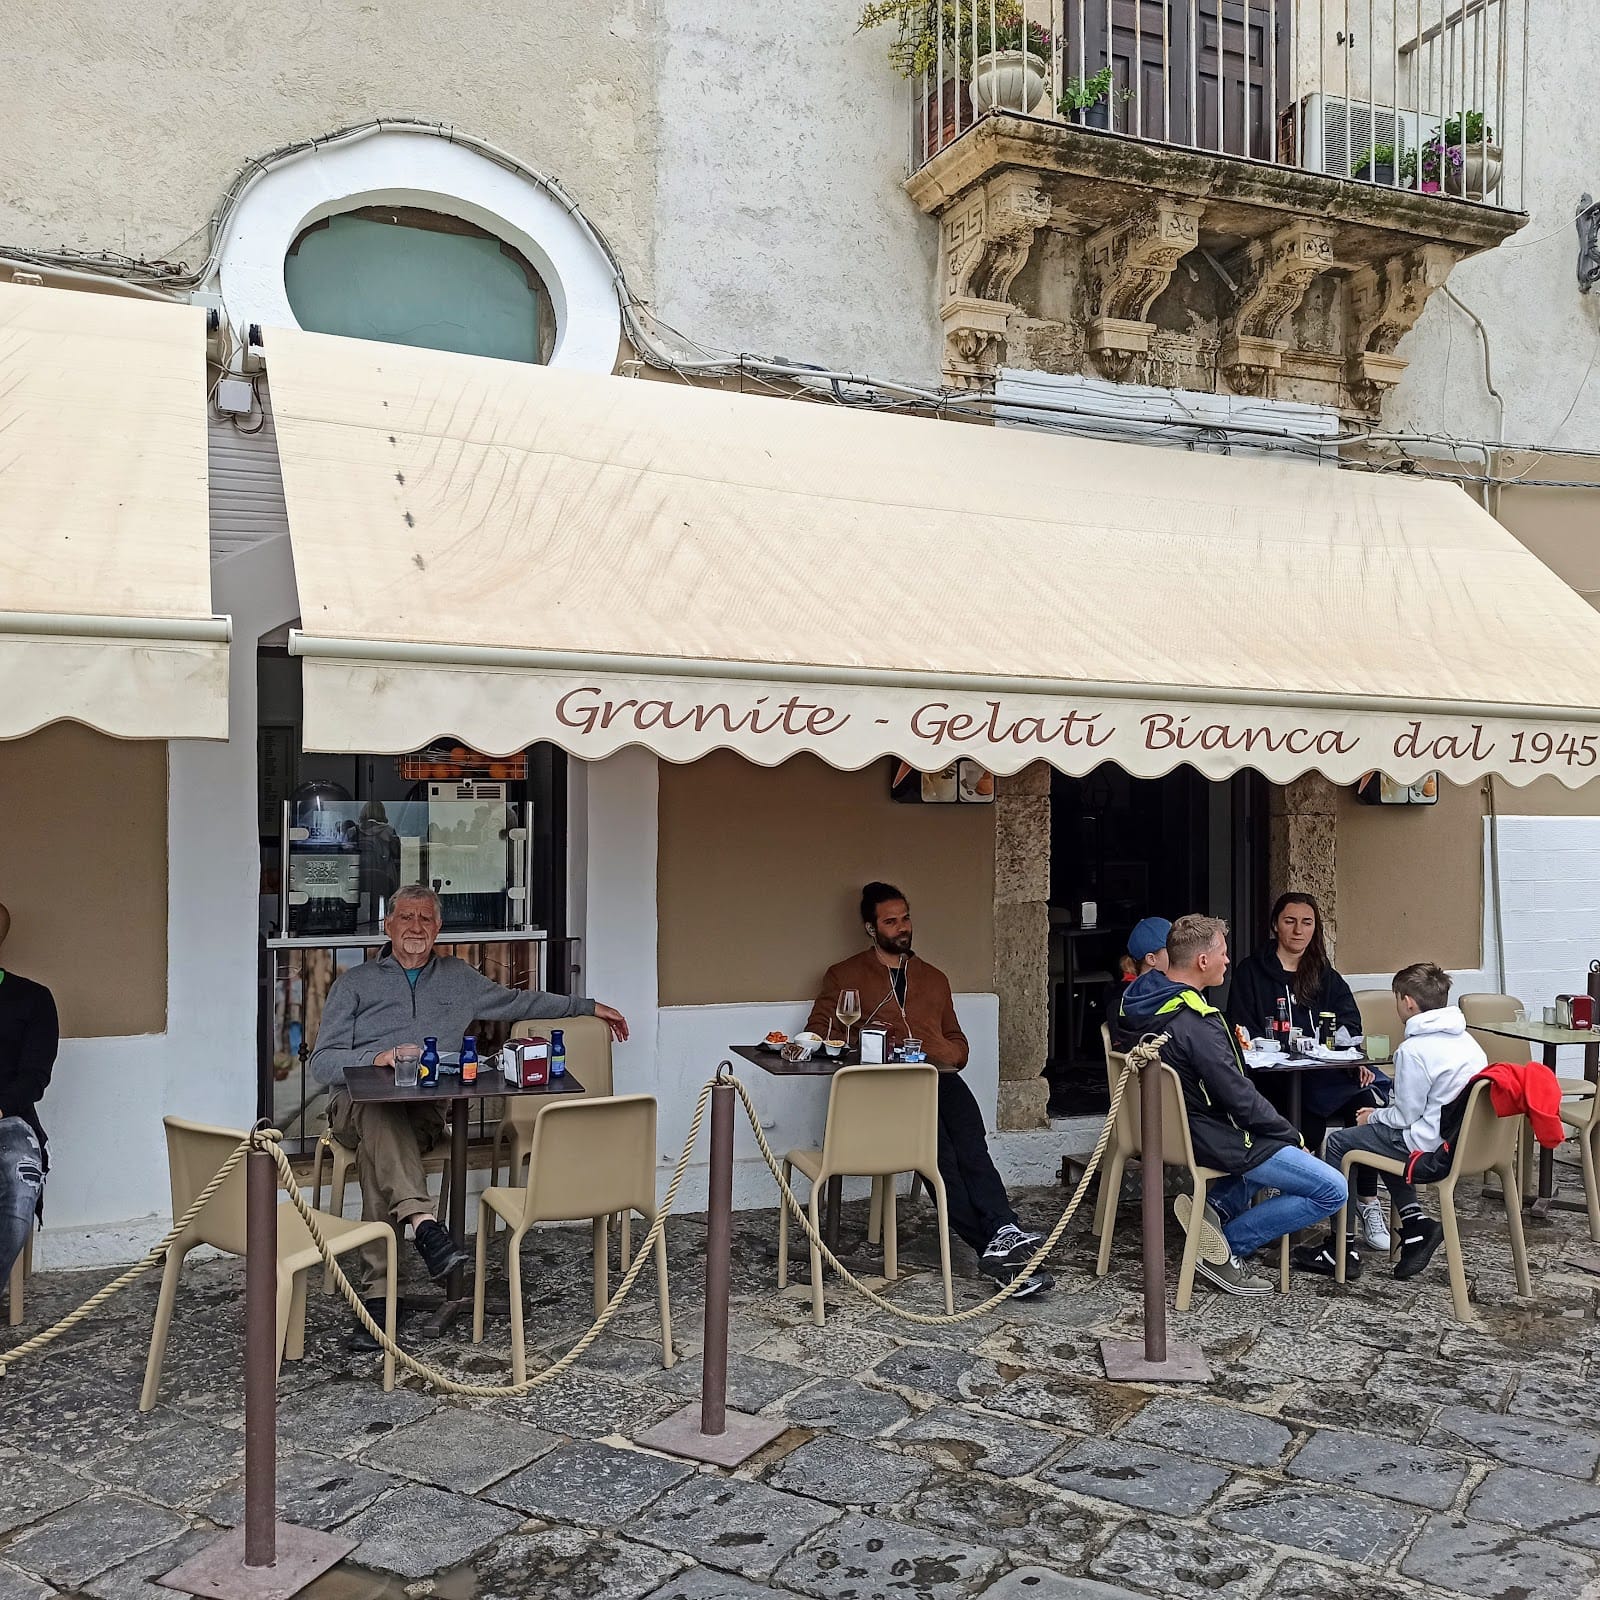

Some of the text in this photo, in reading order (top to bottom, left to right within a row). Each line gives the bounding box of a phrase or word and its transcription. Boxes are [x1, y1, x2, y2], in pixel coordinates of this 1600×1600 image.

[555, 687, 851, 736] Granite
[910, 701, 1115, 747] Gelati
[1140, 713, 1360, 755] Bianca
[1393, 721, 1495, 761] dal
[1509, 731, 1599, 767] 1945
